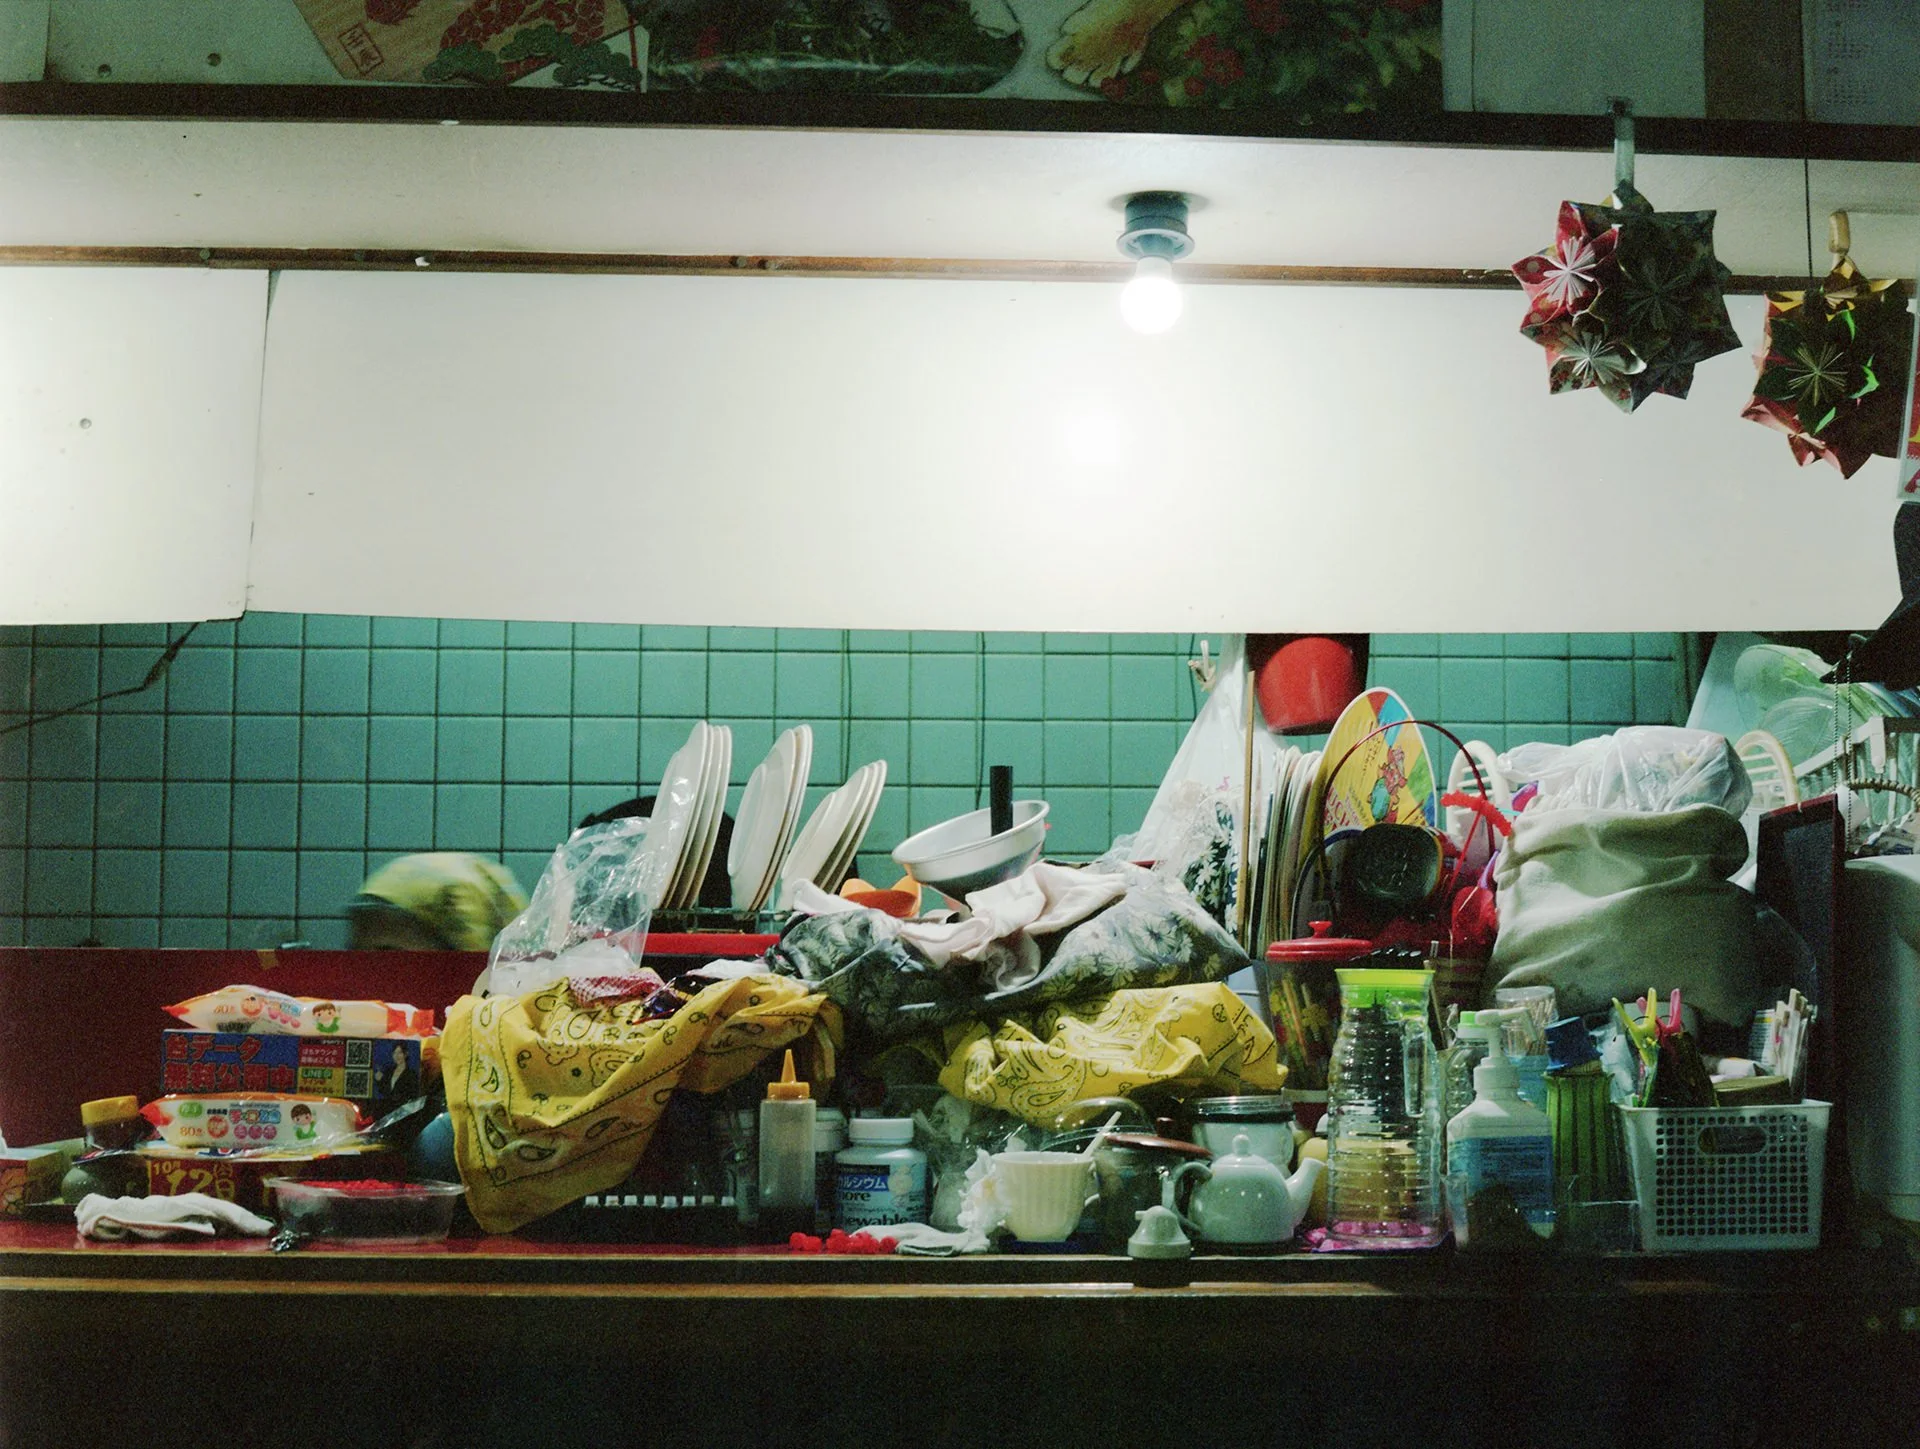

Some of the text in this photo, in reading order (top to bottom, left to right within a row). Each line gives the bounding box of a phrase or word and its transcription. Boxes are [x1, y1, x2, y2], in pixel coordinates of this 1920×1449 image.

[166, 1033, 262, 1063] 台データ
[163, 1061, 296, 1091] 無料公開中
